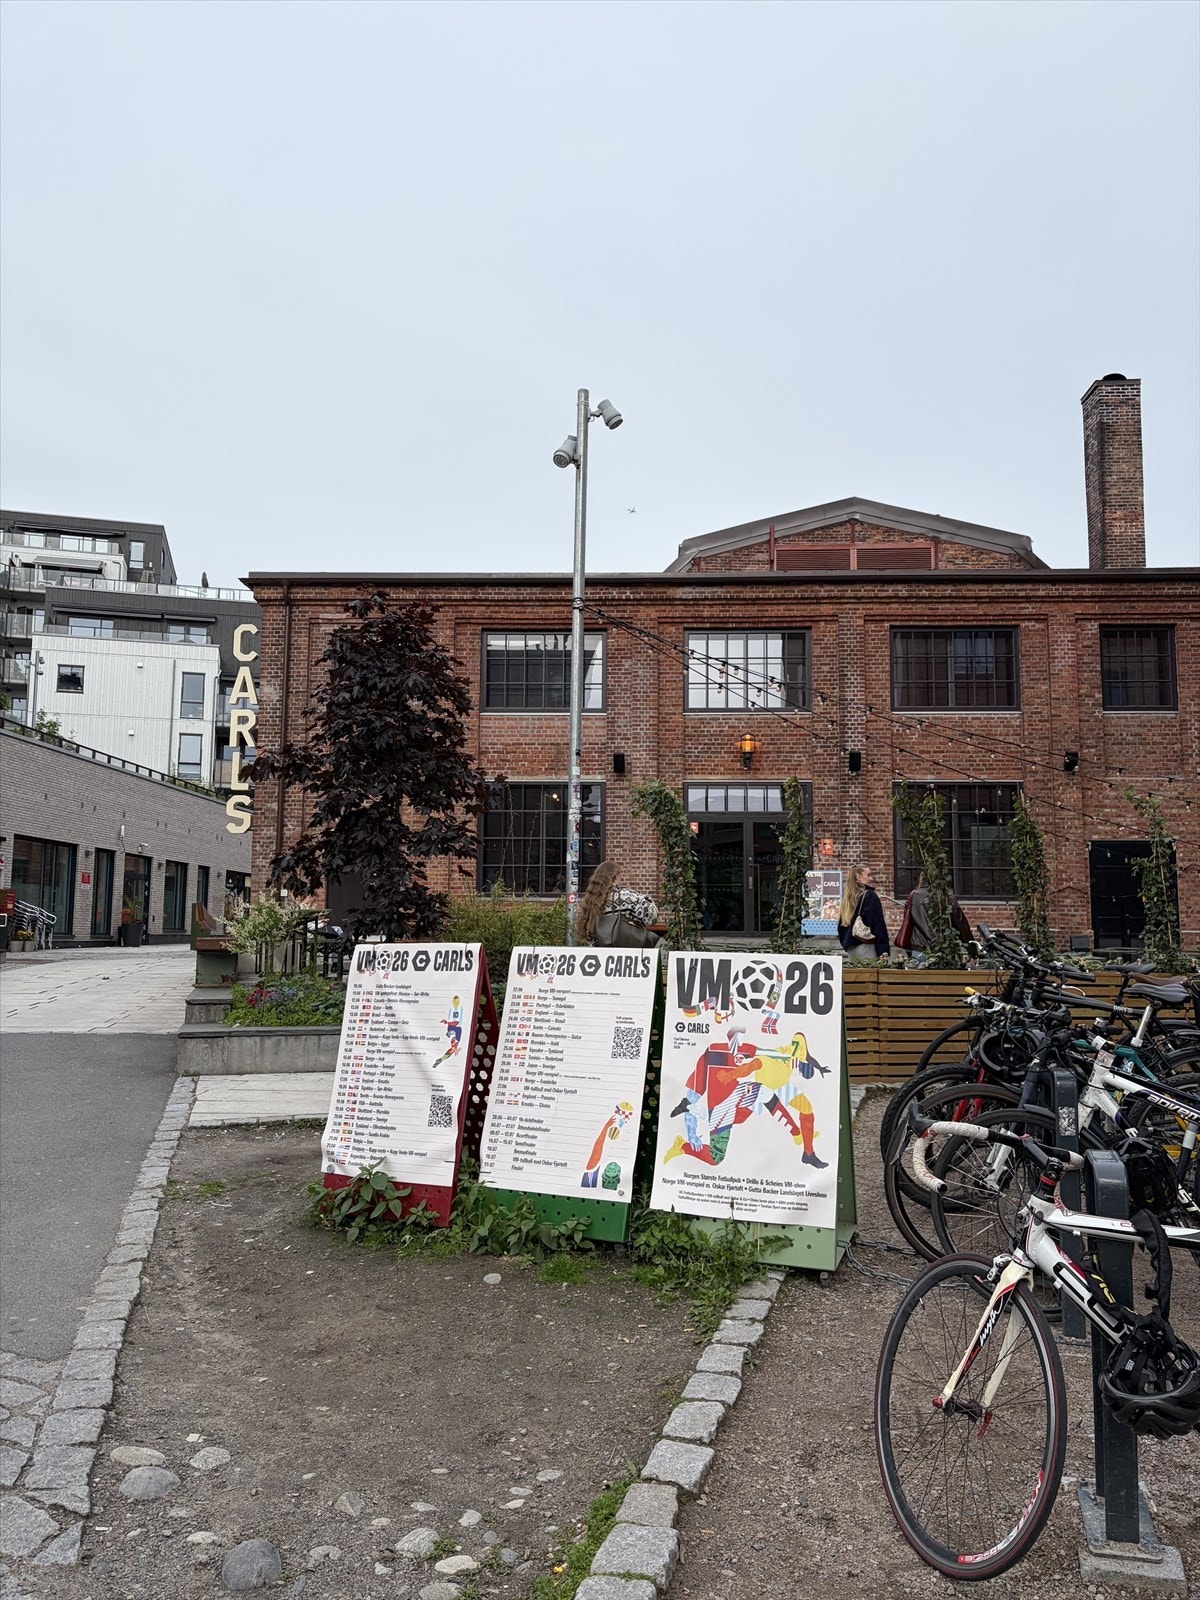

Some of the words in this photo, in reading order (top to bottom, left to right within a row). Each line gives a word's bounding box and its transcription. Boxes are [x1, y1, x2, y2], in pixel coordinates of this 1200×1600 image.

[226, 624, 258, 833] CARLS
[356, 951, 376, 972] VM
[392, 951, 408, 972] 26
[434, 950, 474, 972] CARLS
[517, 953, 540, 974] VM
[556, 954, 575, 976] 26
[604, 955, 651, 978] CARLS
[676, 958, 732, 1010] VM
[784, 961, 834, 1015] 26
[687, 1022, 710, 1034] CARLS
[792, 1040, 800, 1056] 7
[661, 1177, 676, 1185] Norge
[676, 1179, 705, 1188] VM-vorspiel
[711, 1182, 726, 1190] Oskar
[726, 1183, 744, 1192] Fjørtoft
[748, 1185, 762, 1193] Gutta
[762, 1187, 779, 1195] Backer
[779, 1188, 804, 1197] Landslaget
[805, 1190, 827, 1198] Liveshow
[683, 1172, 700, 1180] Norges
[700, 1173, 717, 1181] Største
[717, 1175, 741, 1184] Fotballpub
[745, 1177, 759, 1185] Drillo
